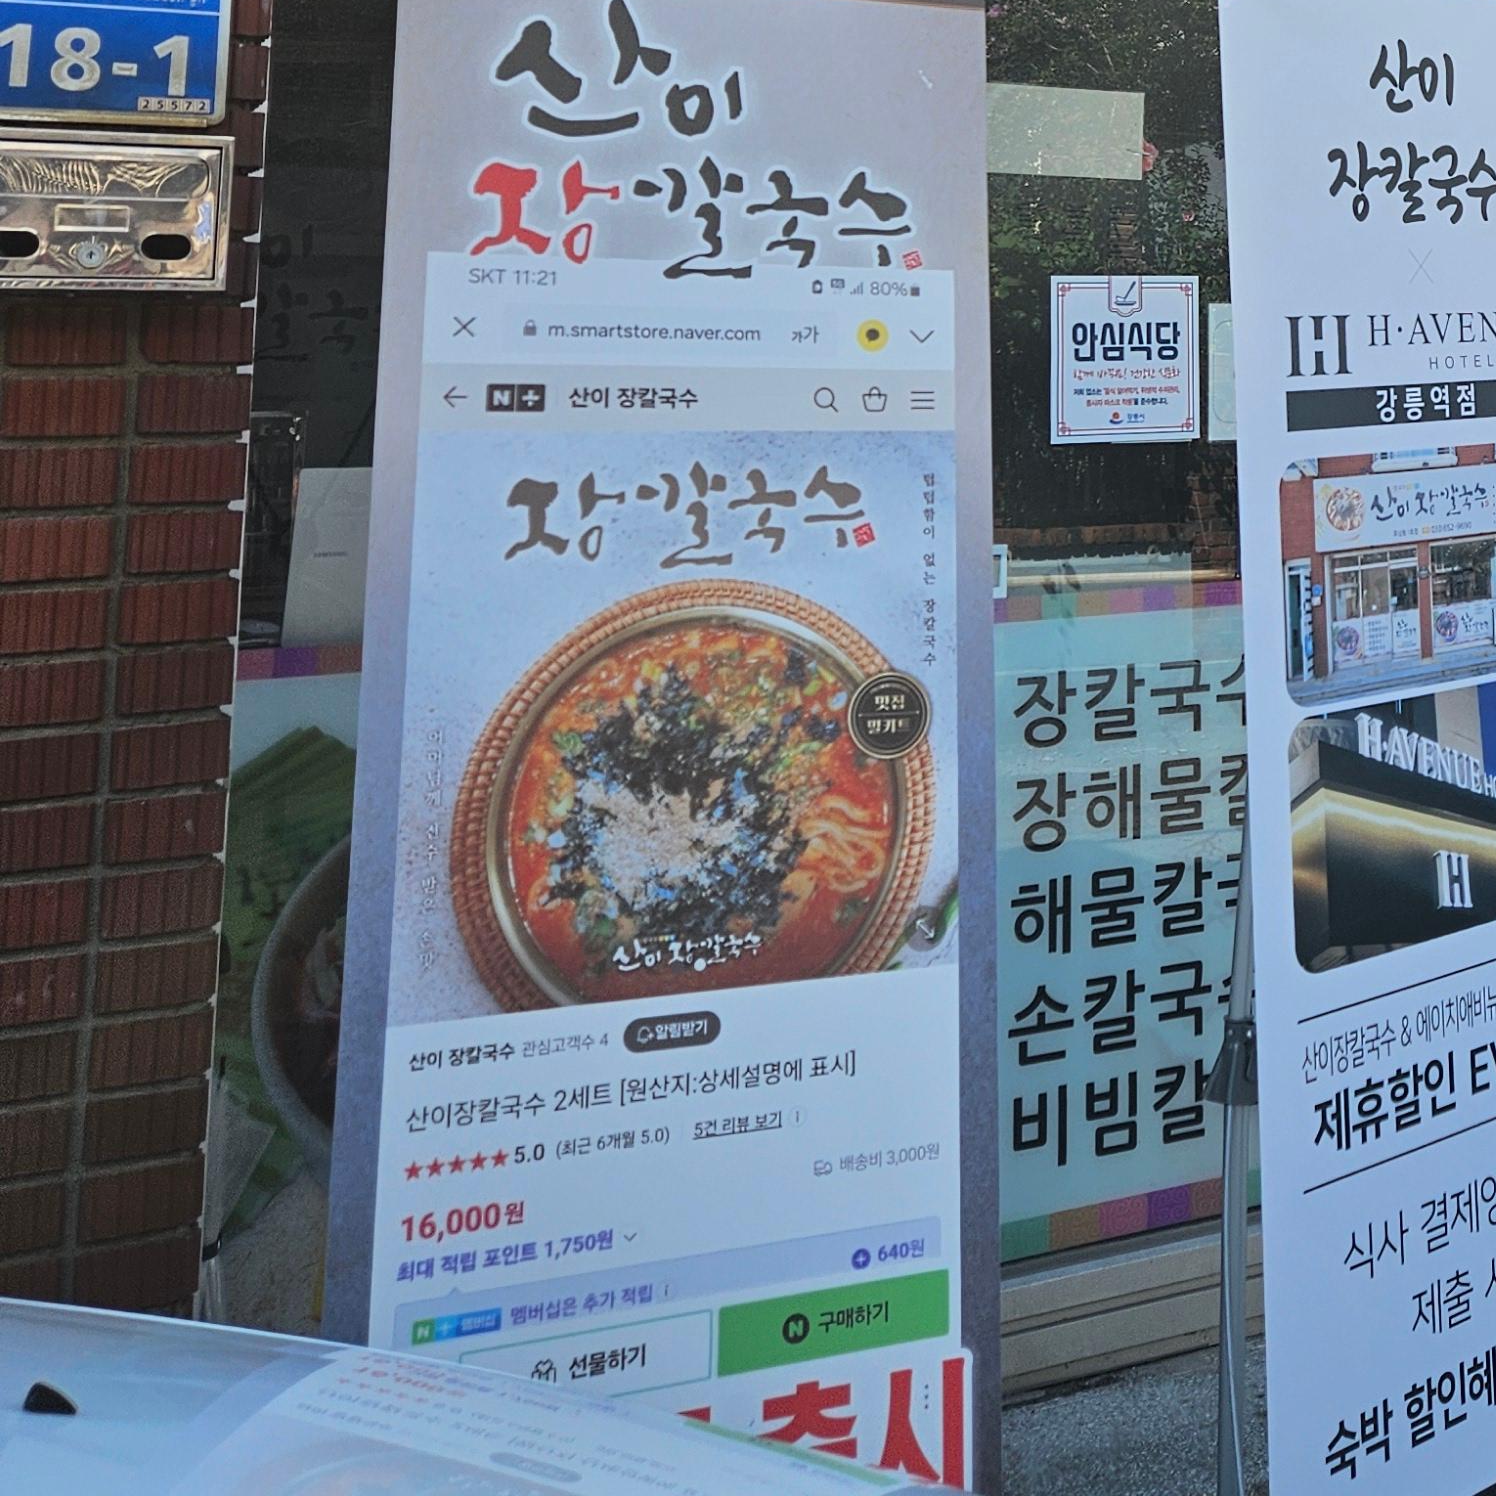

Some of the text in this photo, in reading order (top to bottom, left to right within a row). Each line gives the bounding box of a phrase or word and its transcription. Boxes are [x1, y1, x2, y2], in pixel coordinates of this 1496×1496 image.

[0, 22, 190, 97] 18-1
[1369, 38, 1454, 113] 산이
[141, 99, 206, 112] 25572
[470, 156, 912, 280] 장칼국수
[468, 267, 558, 286] SKT 11:21
[870, 281, 908, 297] 80%
[548, 323, 761, 342] m.smartstore.naver.com
[1071, 321, 1181, 362] 안심식당
[1428, 353, 1495, 370] HOTEL
[568, 386, 699, 409] 산이 장칼국수
[1375, 382, 1477, 424] 강릉역점
[504, 460, 865, 569] 장칼국수
[612, 930, 762, 971] 산이 장칼국수
[1007, 960, 1240, 1067] 손칼국
[408, 1051, 442, 1073] 산이
[448, 1042, 515, 1067] 장칼국수
[521, 1036, 595, 1058] 관심고객수
[1302, 1019, 1397, 1085] 산이장칼국수
[1400, 1014, 1412, 1047] &
[406, 1092, 546, 1134] 산이장칼국수
[553, 1082, 613, 1112] 2세트
[809, 1049, 856, 1079] 표시]
[1313, 1051, 1457, 1151] 제휴할인
[513, 1125, 671, 1164] 5.0 (최근 6개월 5.0)
[694, 1110, 783, 1138] 5건 리뷰 보기
[839, 1142, 940, 1173] 배송비 3,000원
[401, 1200, 525, 1244] 16,000원
[396, 1228, 614, 1283] 최대 적립 포인트 1,750원
[877, 1238, 925, 1262] 640원
[1343, 1207, 1409, 1279] 식사
[510, 1297, 577, 1326] 멤버십은
[583, 1289, 615, 1313] 추가
[621, 1283, 653, 1306] 적립
[818, 1300, 889, 1334] 구매하기
[1411, 1268, 1473, 1336] 제출
[568, 1343, 647, 1381] 선물하기
[1324, 1396, 1394, 1480] 숙박
